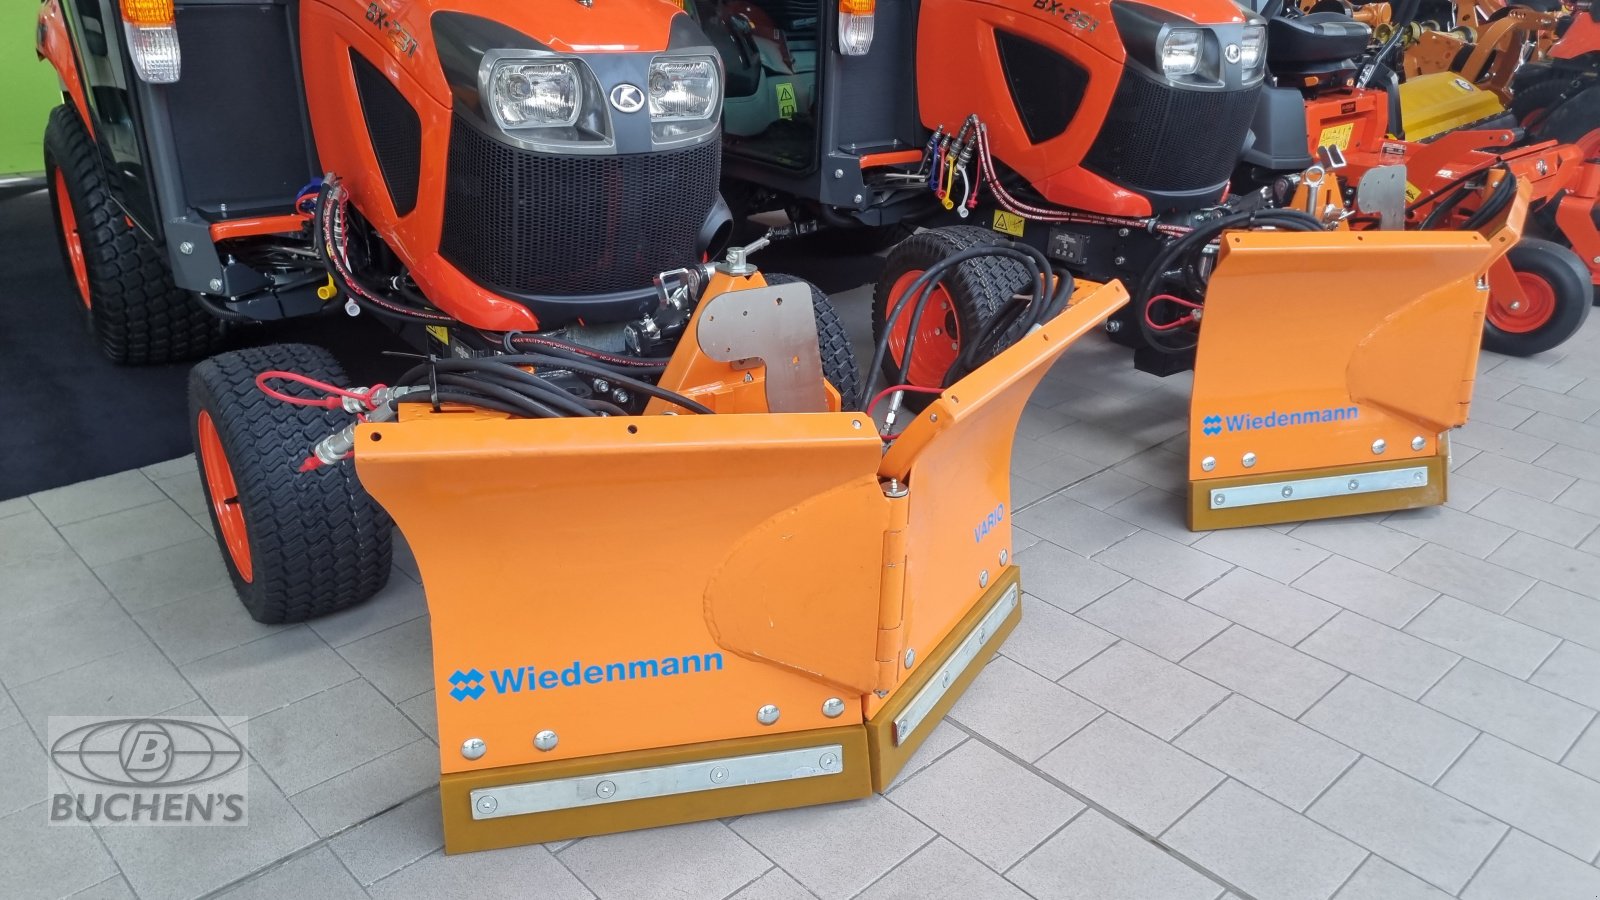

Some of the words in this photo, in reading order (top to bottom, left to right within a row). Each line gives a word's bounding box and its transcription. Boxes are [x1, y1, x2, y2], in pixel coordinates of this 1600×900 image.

[1225, 406, 1359, 433] Wiedenmann
[974, 503, 1004, 543] VARIO
[489, 652, 723, 695] Wiedenmann
